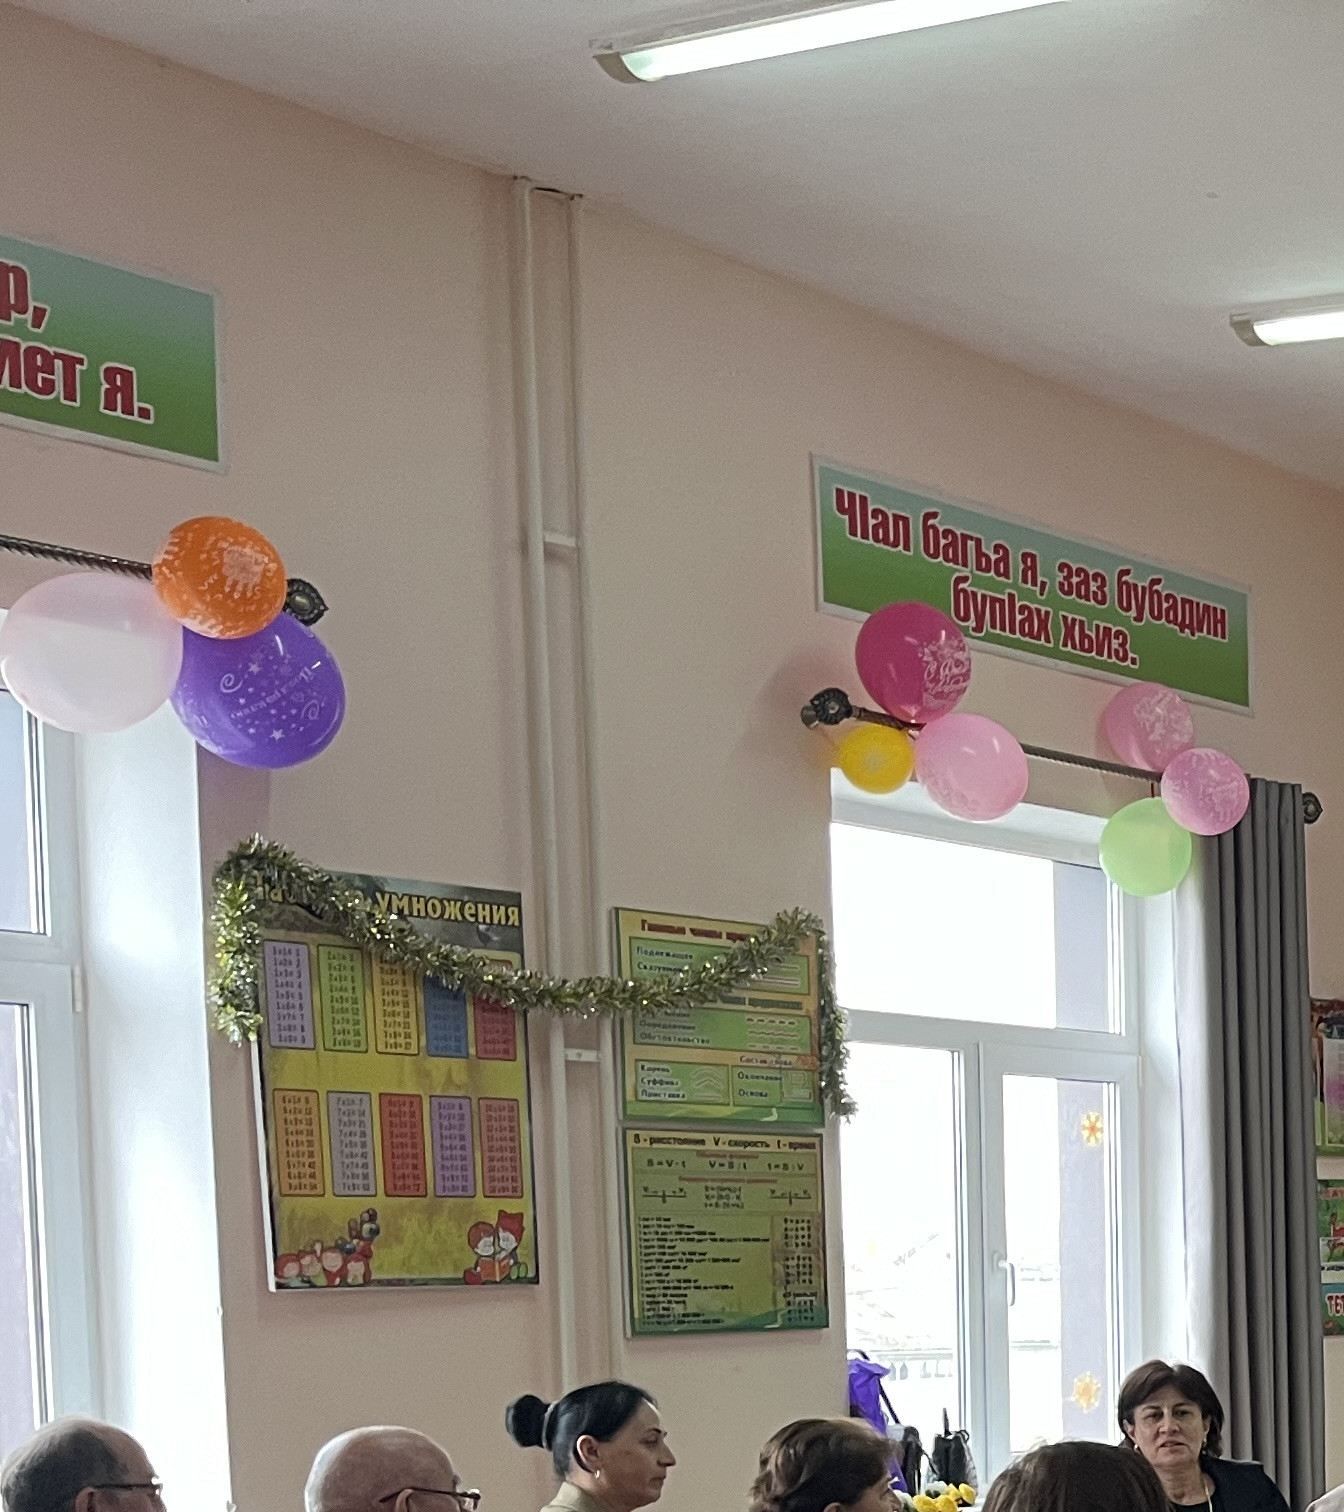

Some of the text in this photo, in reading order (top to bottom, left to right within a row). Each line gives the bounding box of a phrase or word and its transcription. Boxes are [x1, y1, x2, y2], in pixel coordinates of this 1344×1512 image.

[102, 365, 151, 421] я.
[1020, 551, 1048, 597] я,
[1058, 561, 1107, 606] заз
[1116, 568, 1227, 641] бубадин
[1061, 614, 1138, 667] хьиз.
[376, 890, 521, 927] умножения
